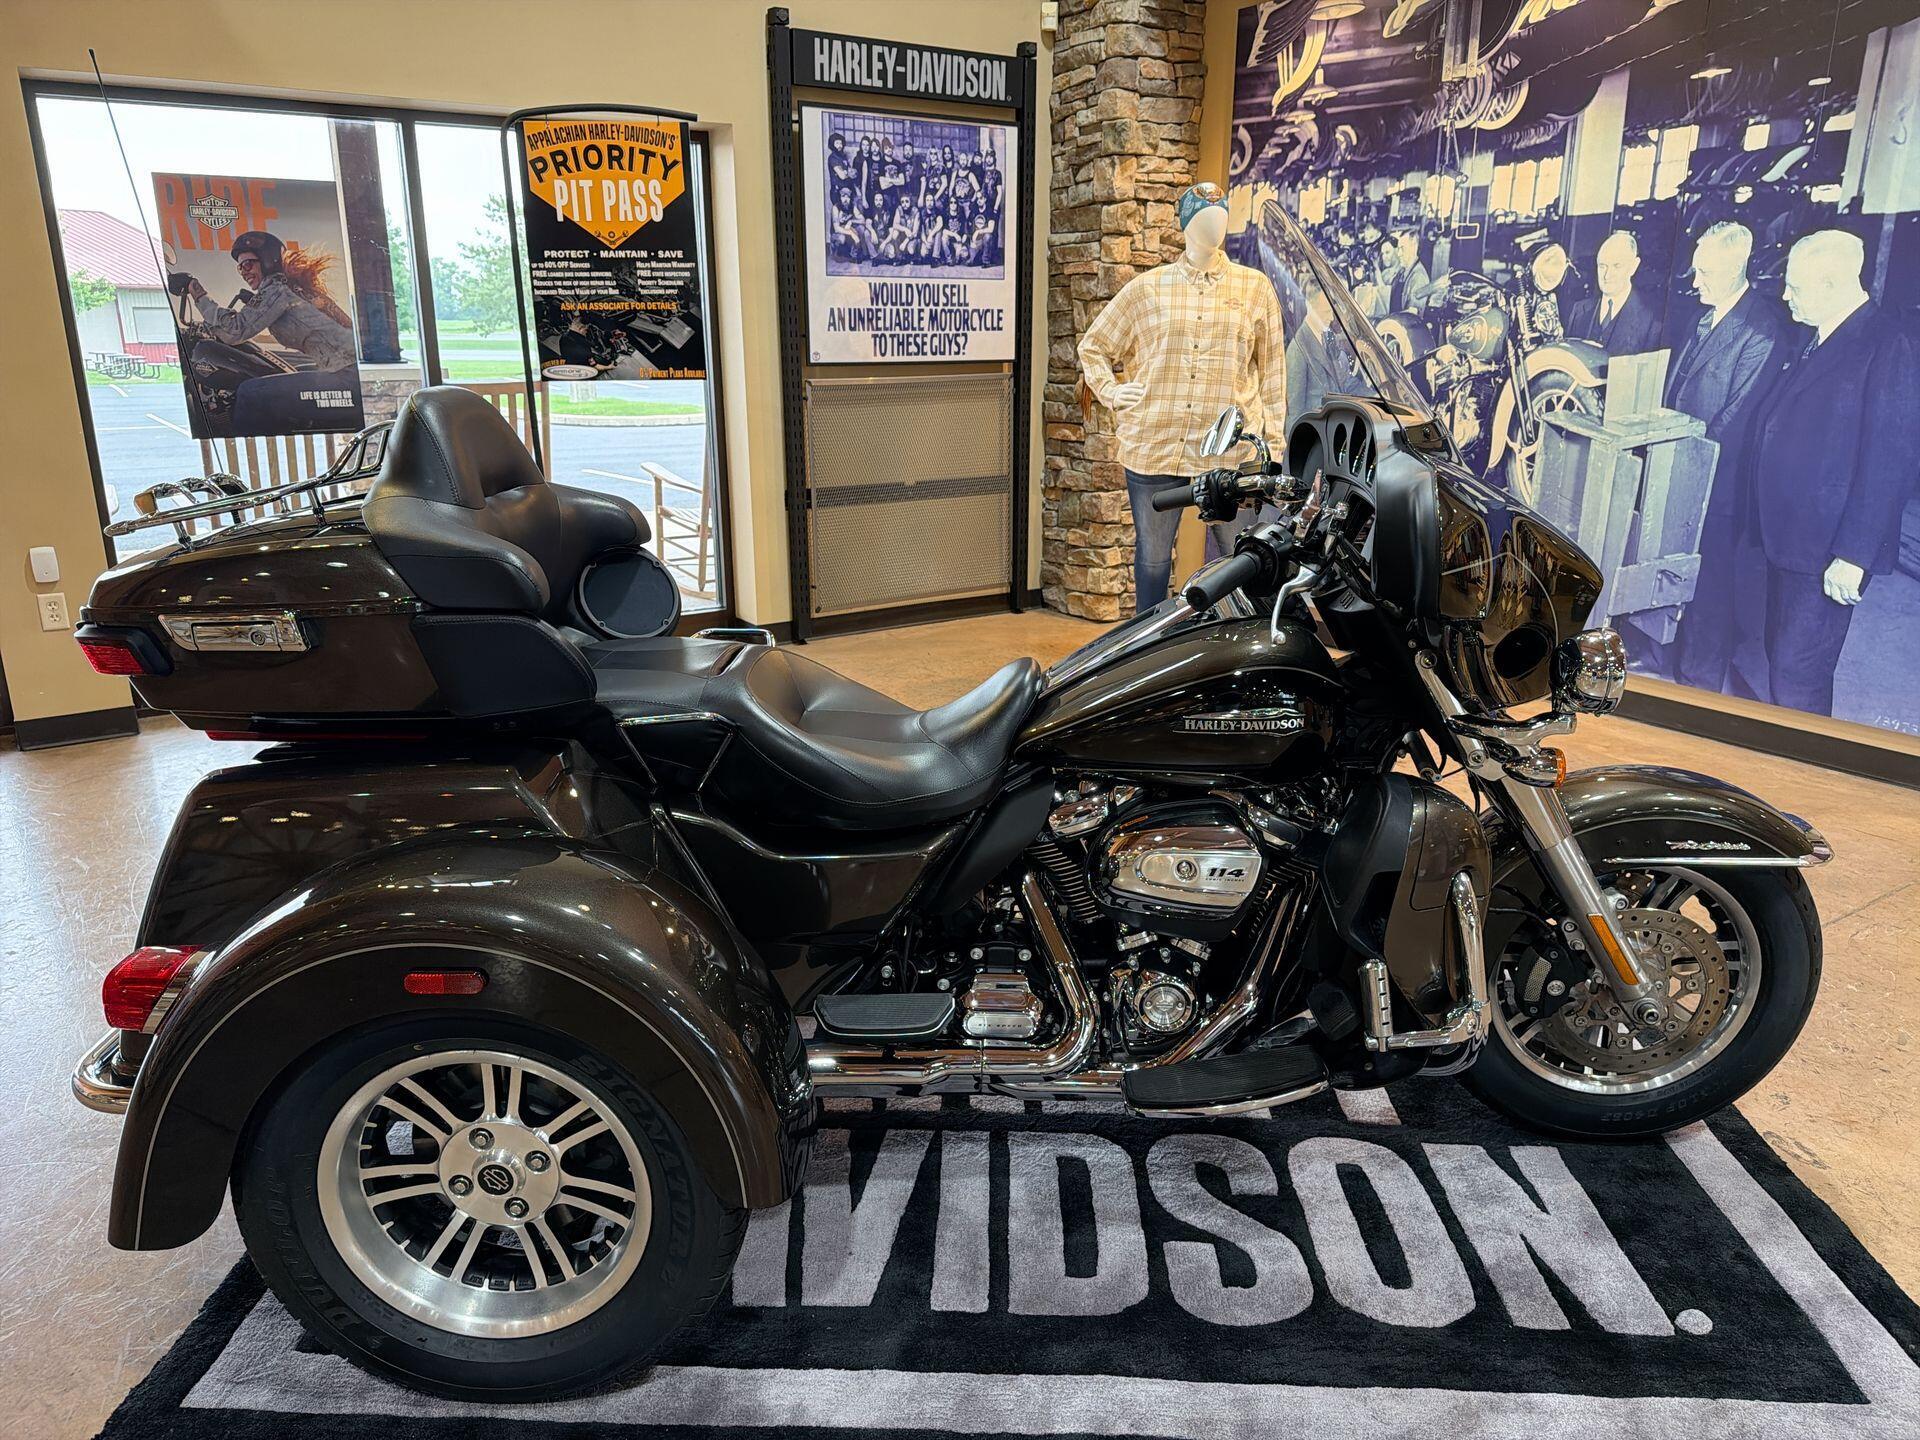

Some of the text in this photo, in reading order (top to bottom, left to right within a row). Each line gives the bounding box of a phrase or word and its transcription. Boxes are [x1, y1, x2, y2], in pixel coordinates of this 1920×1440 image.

[813, 37, 1007, 101] HARLEY-DAVIDSON
[526, 123, 677, 152] APPALACHIAN HARLEY-DAVIDSON'S
[528, 144, 681, 184] PRIORITY
[201, 197, 225, 208] MOTOR
[553, 179, 664, 222] PIT PASS
[192, 207, 237, 218] HARLEY-DAVIDSON
[203, 217, 228, 229] CYCLES
[544, 250, 683, 259] PROTECT MAINTAIN SAVE
[557, 261, 569, 269] OFF
[532, 270, 547, 278] FREE
[868, 282, 969, 307] WOULD YOU SELL
[560, 301, 677, 311] ASK AN ASSOCIATE FOR DETAILS
[827, 307, 1003, 332] AN UNRELIABLE MOTORCYCLE
[871, 332, 968, 357] TO THESE GUYS?
[300, 390, 352, 401] LIFE IS BETTER ON
[316, 399, 330, 408] TWO
[1184, 718, 1305, 731] HARLEY-DAVIDSON
[1209, 868, 1246, 878] 114
